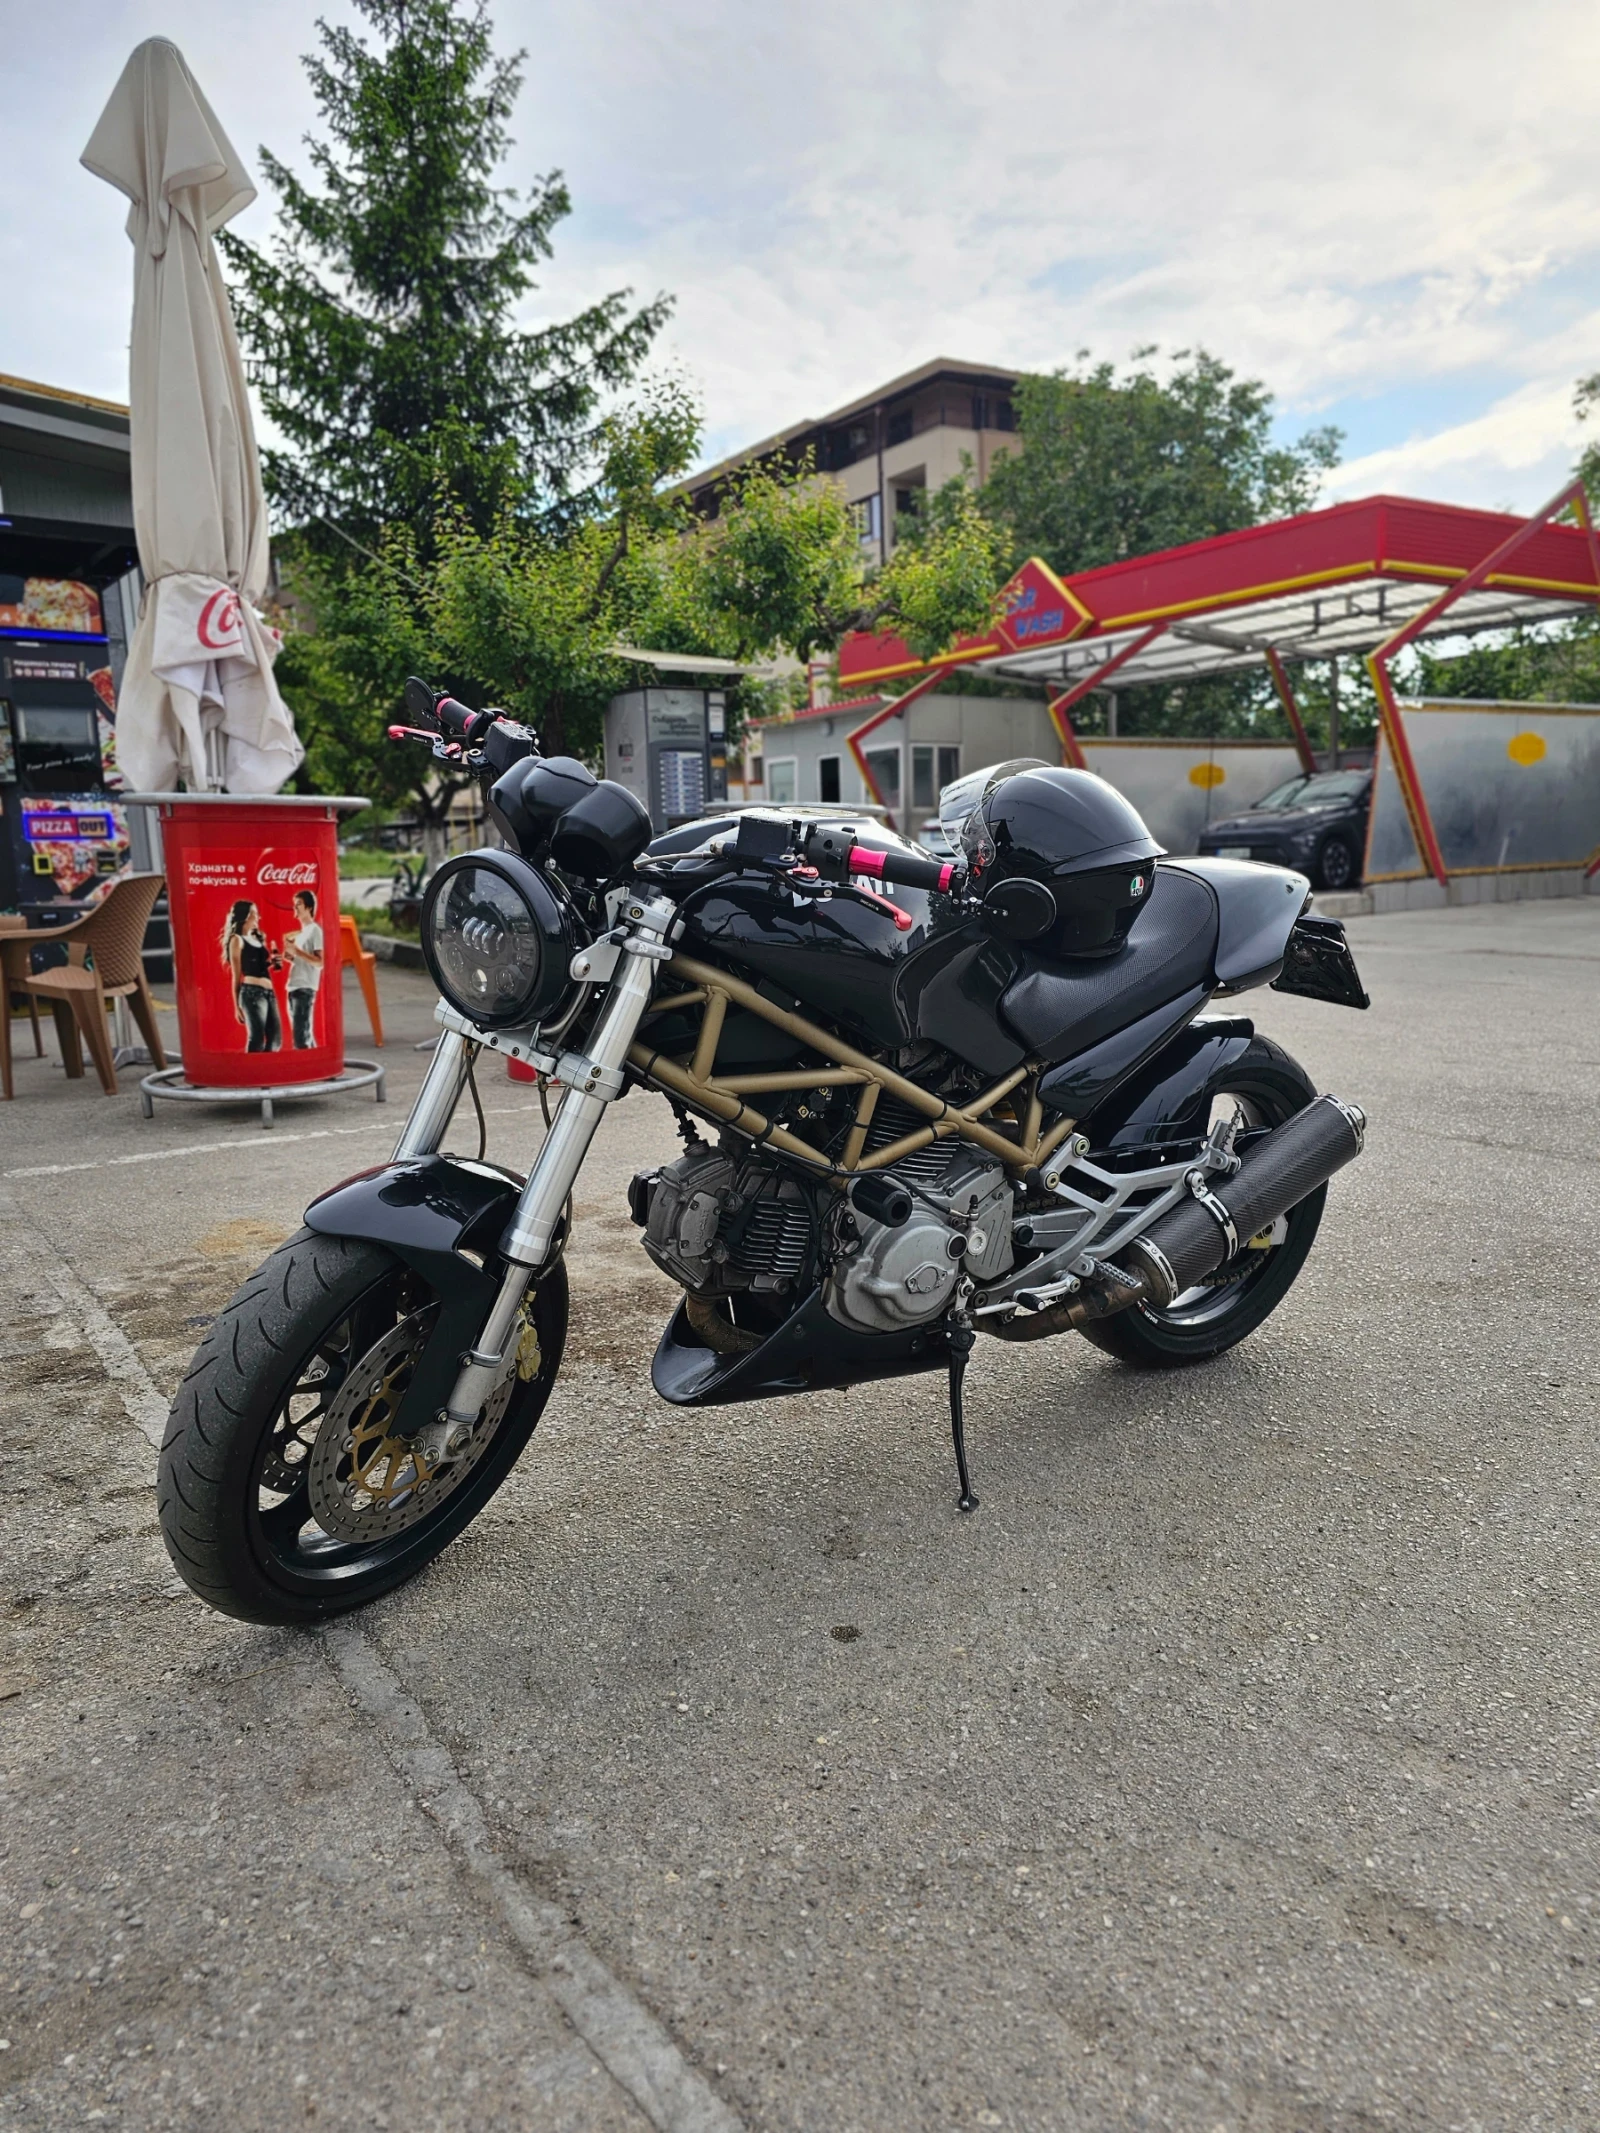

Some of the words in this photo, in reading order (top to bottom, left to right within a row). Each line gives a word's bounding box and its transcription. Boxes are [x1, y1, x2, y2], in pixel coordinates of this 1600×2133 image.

[1015, 609, 1063, 638] WASH
[31, 820, 73, 834] PIZZA
[80, 821, 107, 833] OUT
[188, 863, 234, 874] Храната
[257, 863, 318, 885] Coca-Cola
[189, 876, 238, 887] по-вкусна
